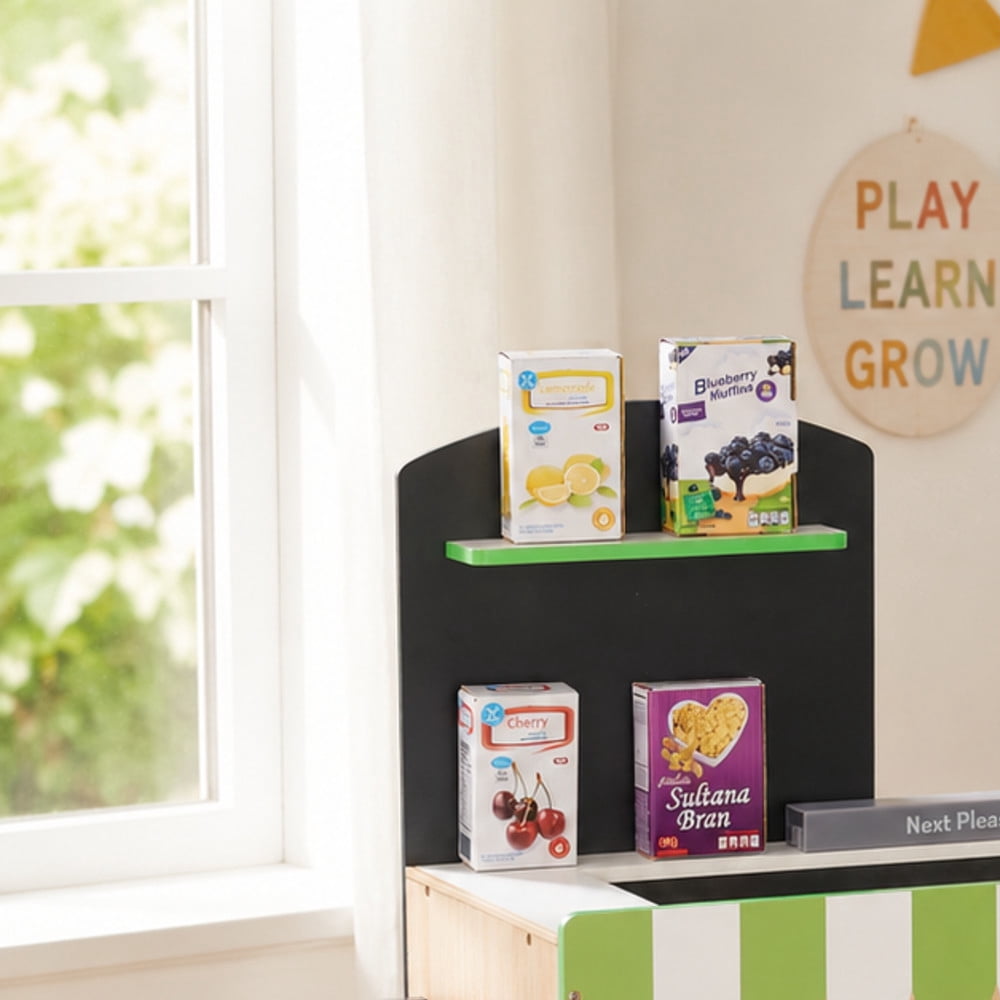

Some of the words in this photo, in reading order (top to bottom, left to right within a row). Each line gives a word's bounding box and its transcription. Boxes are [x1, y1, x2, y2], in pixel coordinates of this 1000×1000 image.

[856, 180, 980, 230] PLAY
[840, 259, 996, 310] LEARN
[844, 338, 990, 389] GROW
[507, 715, 548, 729] Cherry
[665, 782, 751, 811] Sultana
[676, 808, 731, 831] Bran
[905, 814, 952, 835] Next
